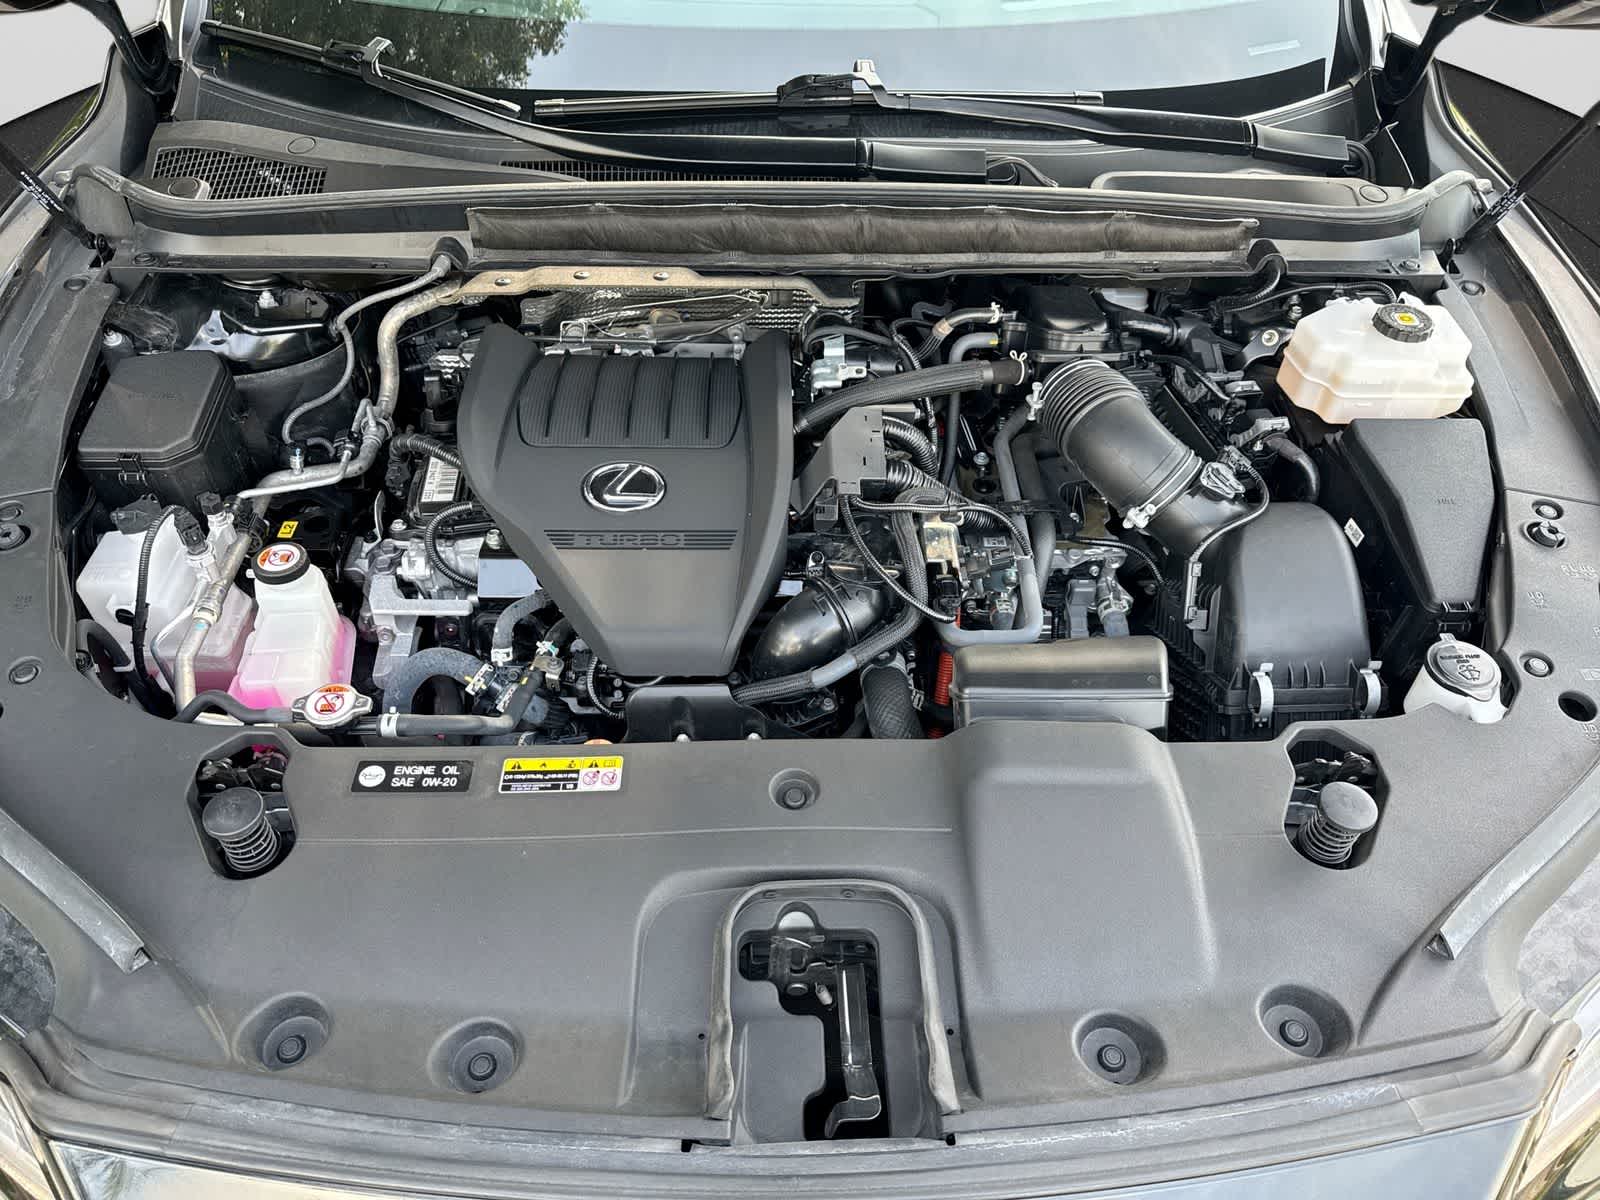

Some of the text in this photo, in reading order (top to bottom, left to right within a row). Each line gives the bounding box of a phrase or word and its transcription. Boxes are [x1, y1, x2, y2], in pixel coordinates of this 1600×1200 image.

[577, 533, 683, 546] TURBO
[393, 765, 460, 775] ENGINE OIL
[391, 777, 458, 787] SAE 0W-20
